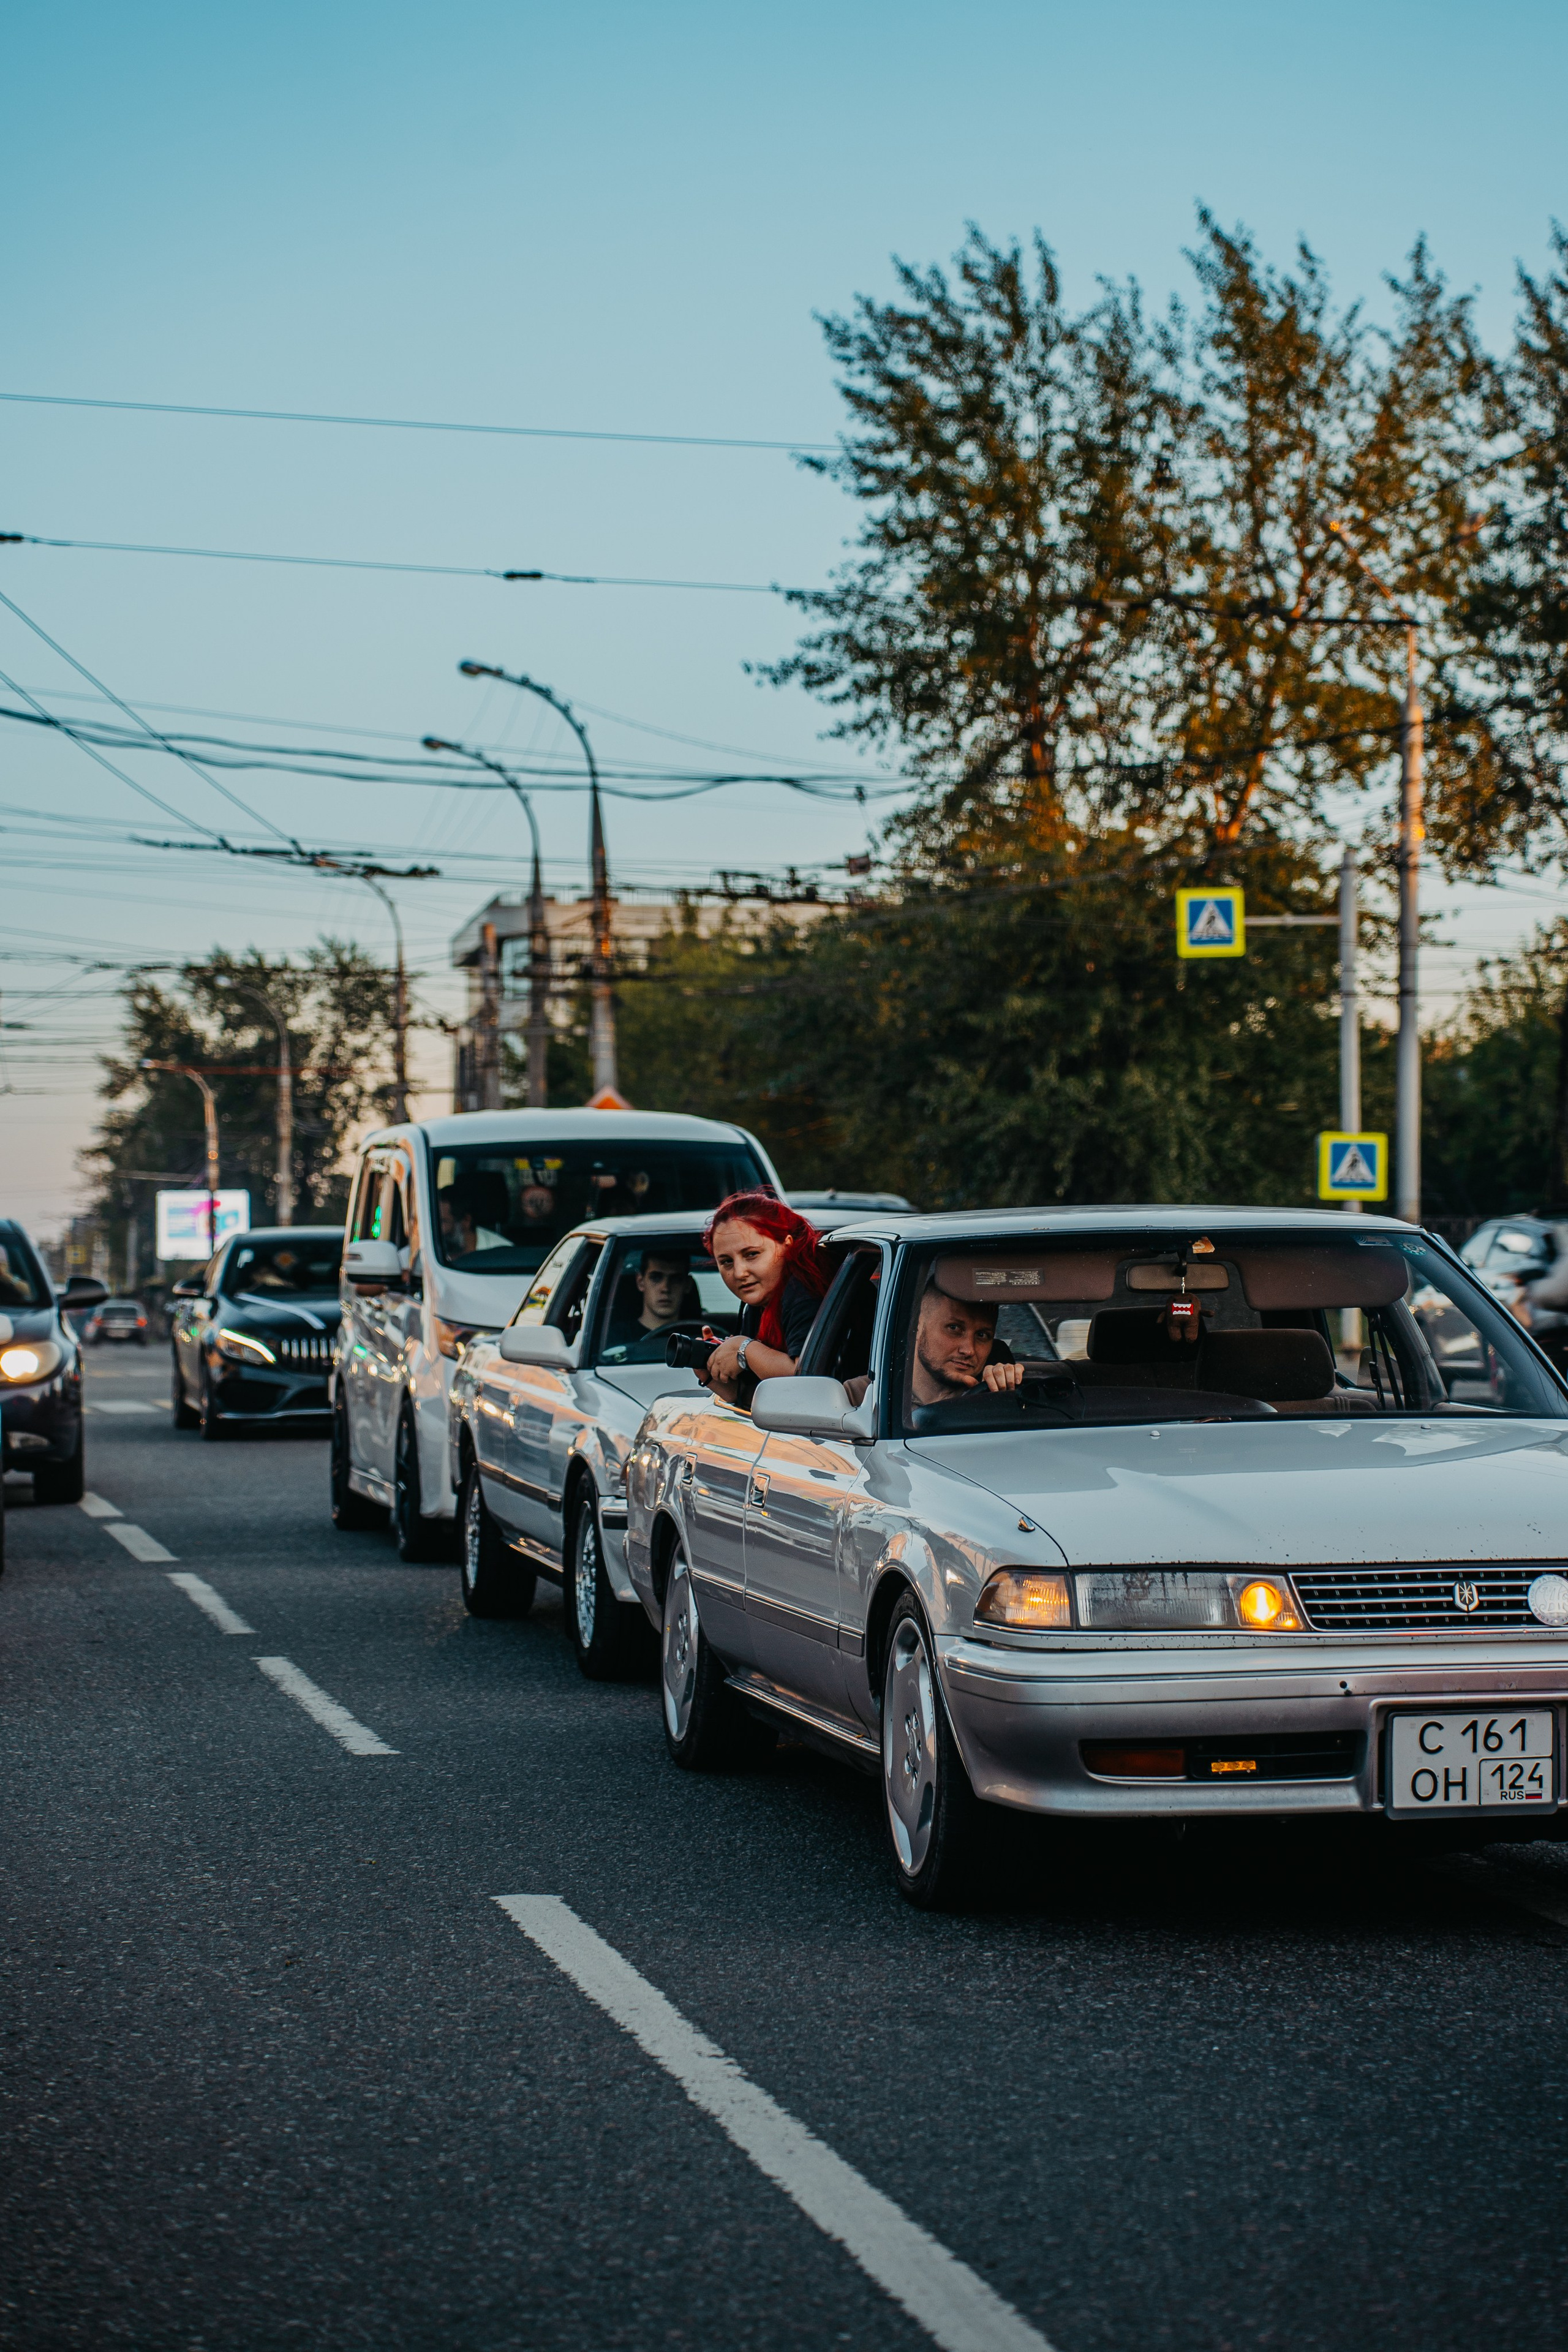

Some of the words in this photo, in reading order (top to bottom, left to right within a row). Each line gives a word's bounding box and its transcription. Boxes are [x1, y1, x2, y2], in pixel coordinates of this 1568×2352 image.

[1460, 1718, 1527, 1753] 161
[1490, 1762, 1544, 1790] 124
[1500, 1791, 1525, 1800] RUS
